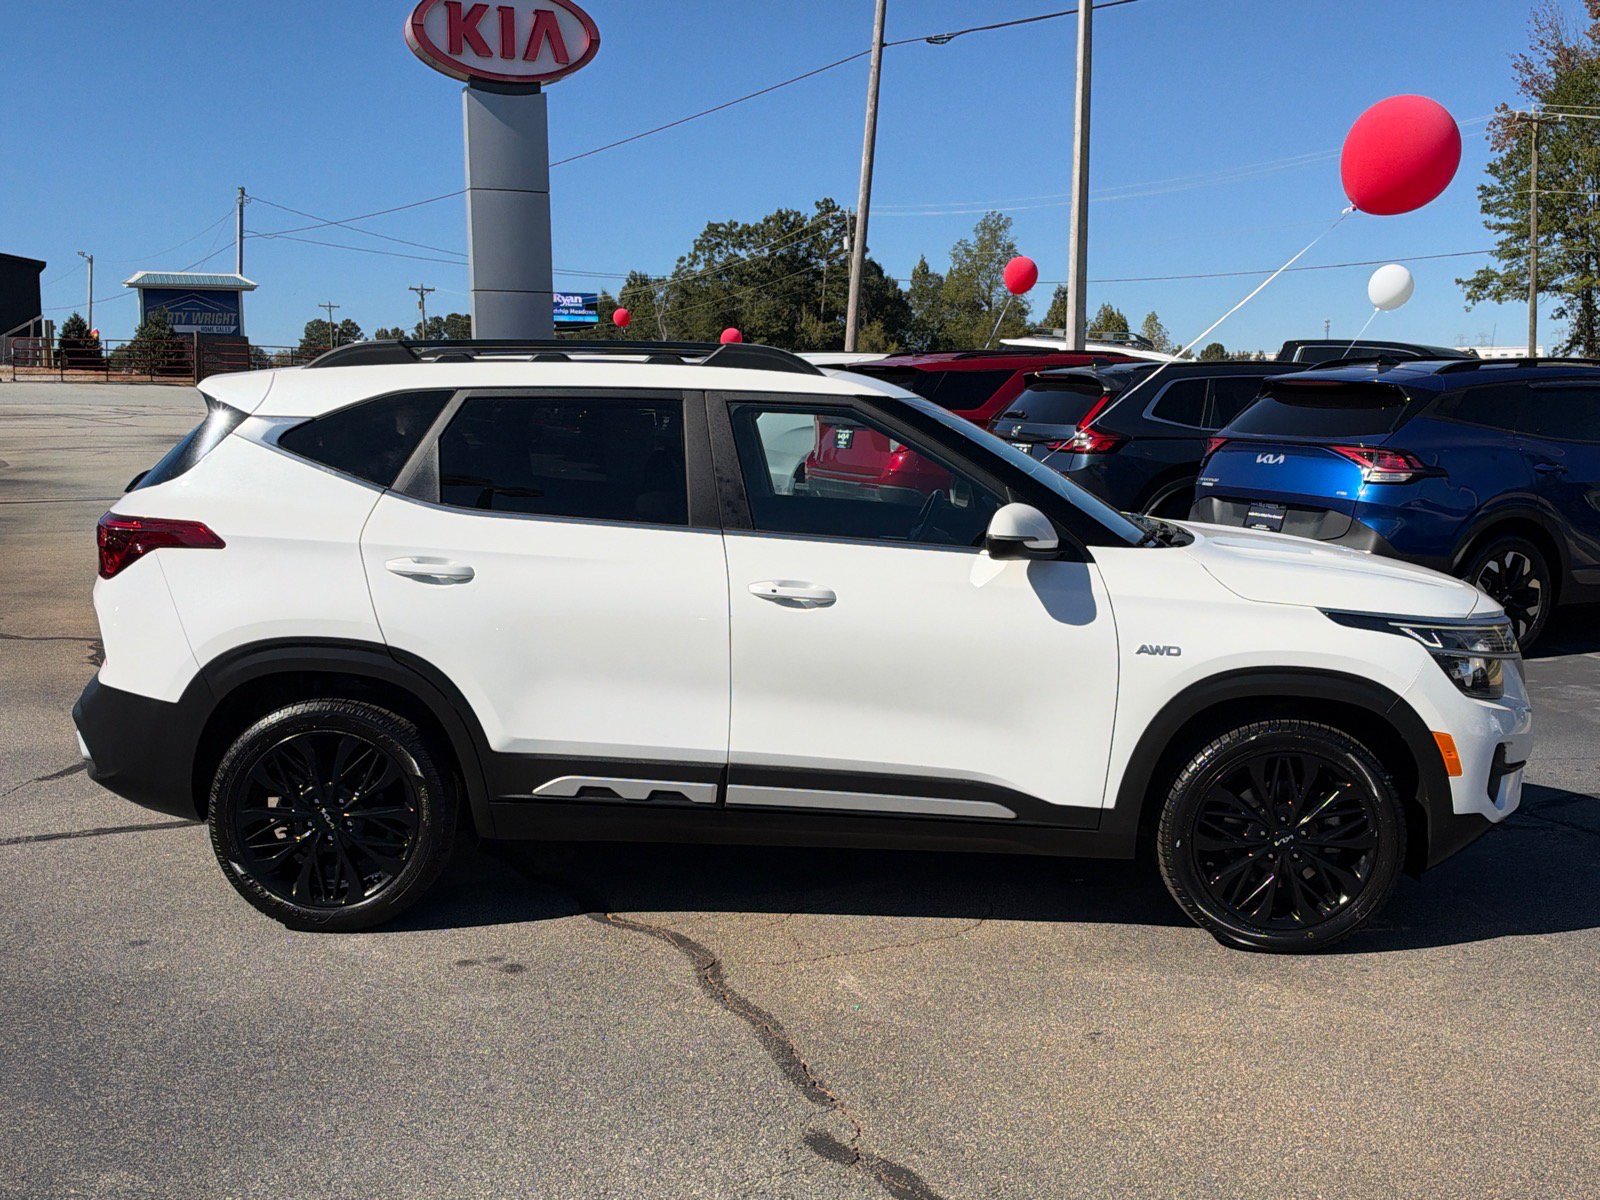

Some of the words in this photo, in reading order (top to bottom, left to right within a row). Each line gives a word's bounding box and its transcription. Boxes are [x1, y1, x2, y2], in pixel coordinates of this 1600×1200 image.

[444, 1, 569, 64] KIA
[553, 293, 582, 306] Ryan
[192, 312, 237, 325] WRIGHT
[1256, 453, 1285, 464] KIA
[1135, 644, 1181, 657] AWD
